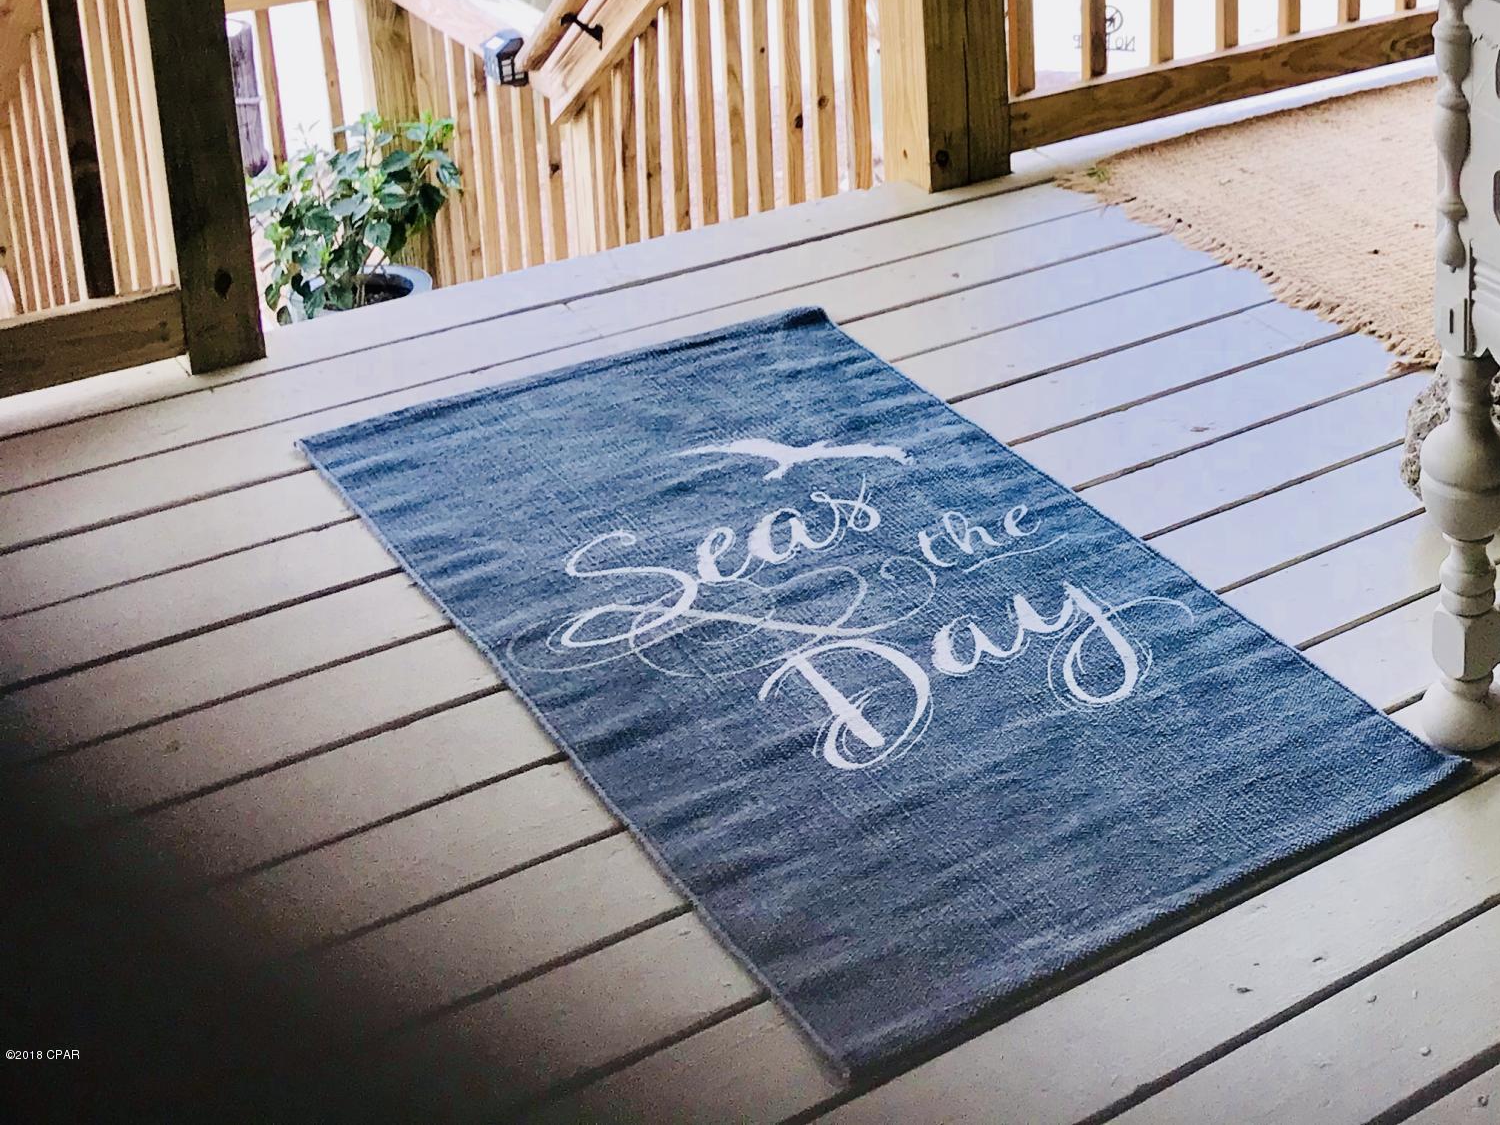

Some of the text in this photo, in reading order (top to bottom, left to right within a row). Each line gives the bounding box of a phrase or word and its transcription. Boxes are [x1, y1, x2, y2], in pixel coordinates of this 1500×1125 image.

[510, 475, 1066, 675] Seas the
[757, 579, 1194, 770] Day
